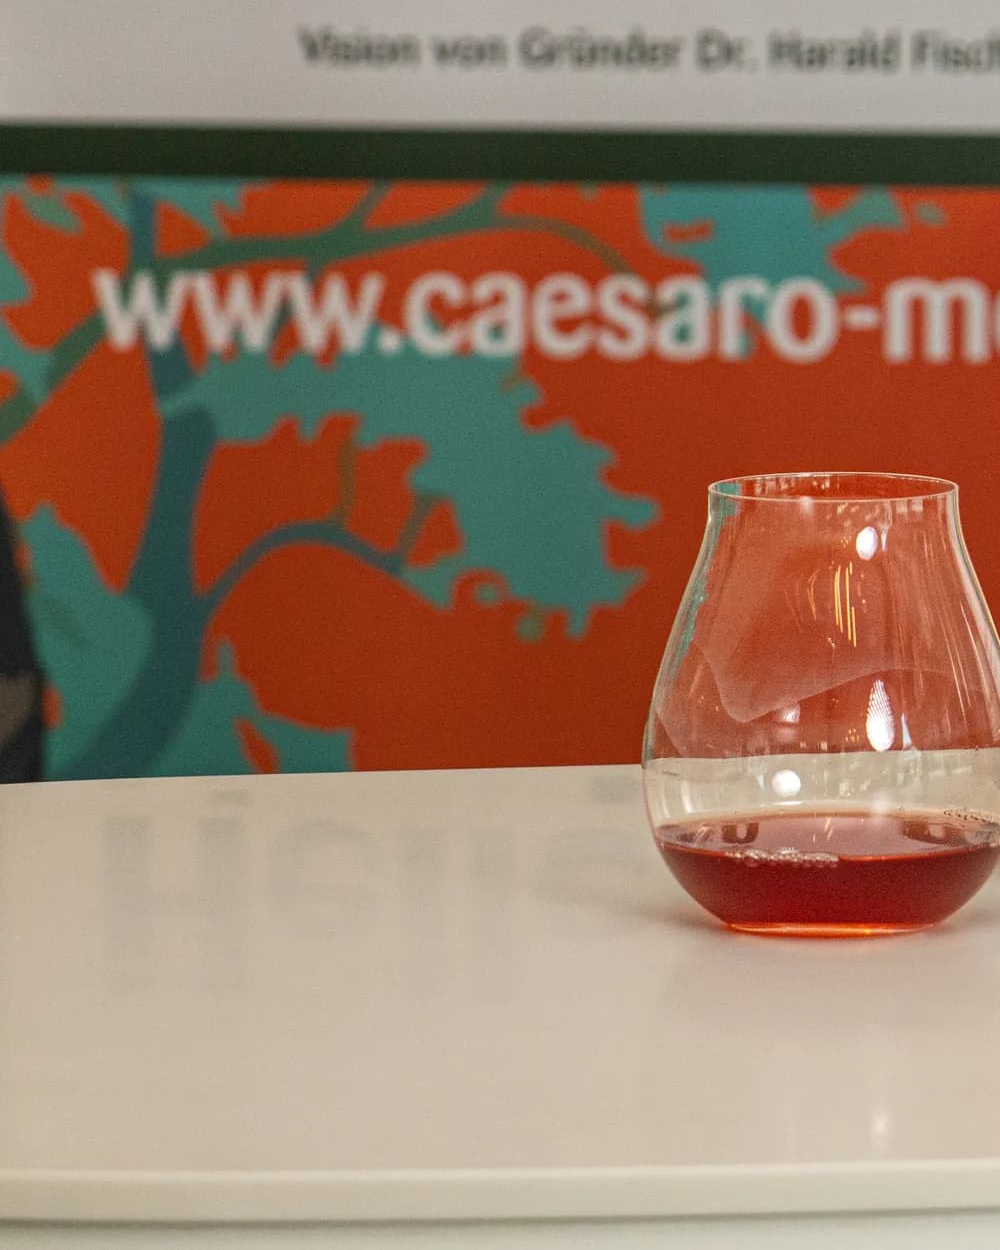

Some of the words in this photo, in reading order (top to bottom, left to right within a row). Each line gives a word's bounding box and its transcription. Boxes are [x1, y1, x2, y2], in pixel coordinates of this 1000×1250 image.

[430, 34, 508, 69] von
[516, 24, 684, 71] Gründer
[694, 27, 759, 72] Dr.
[766, 27, 902, 72] Harald
